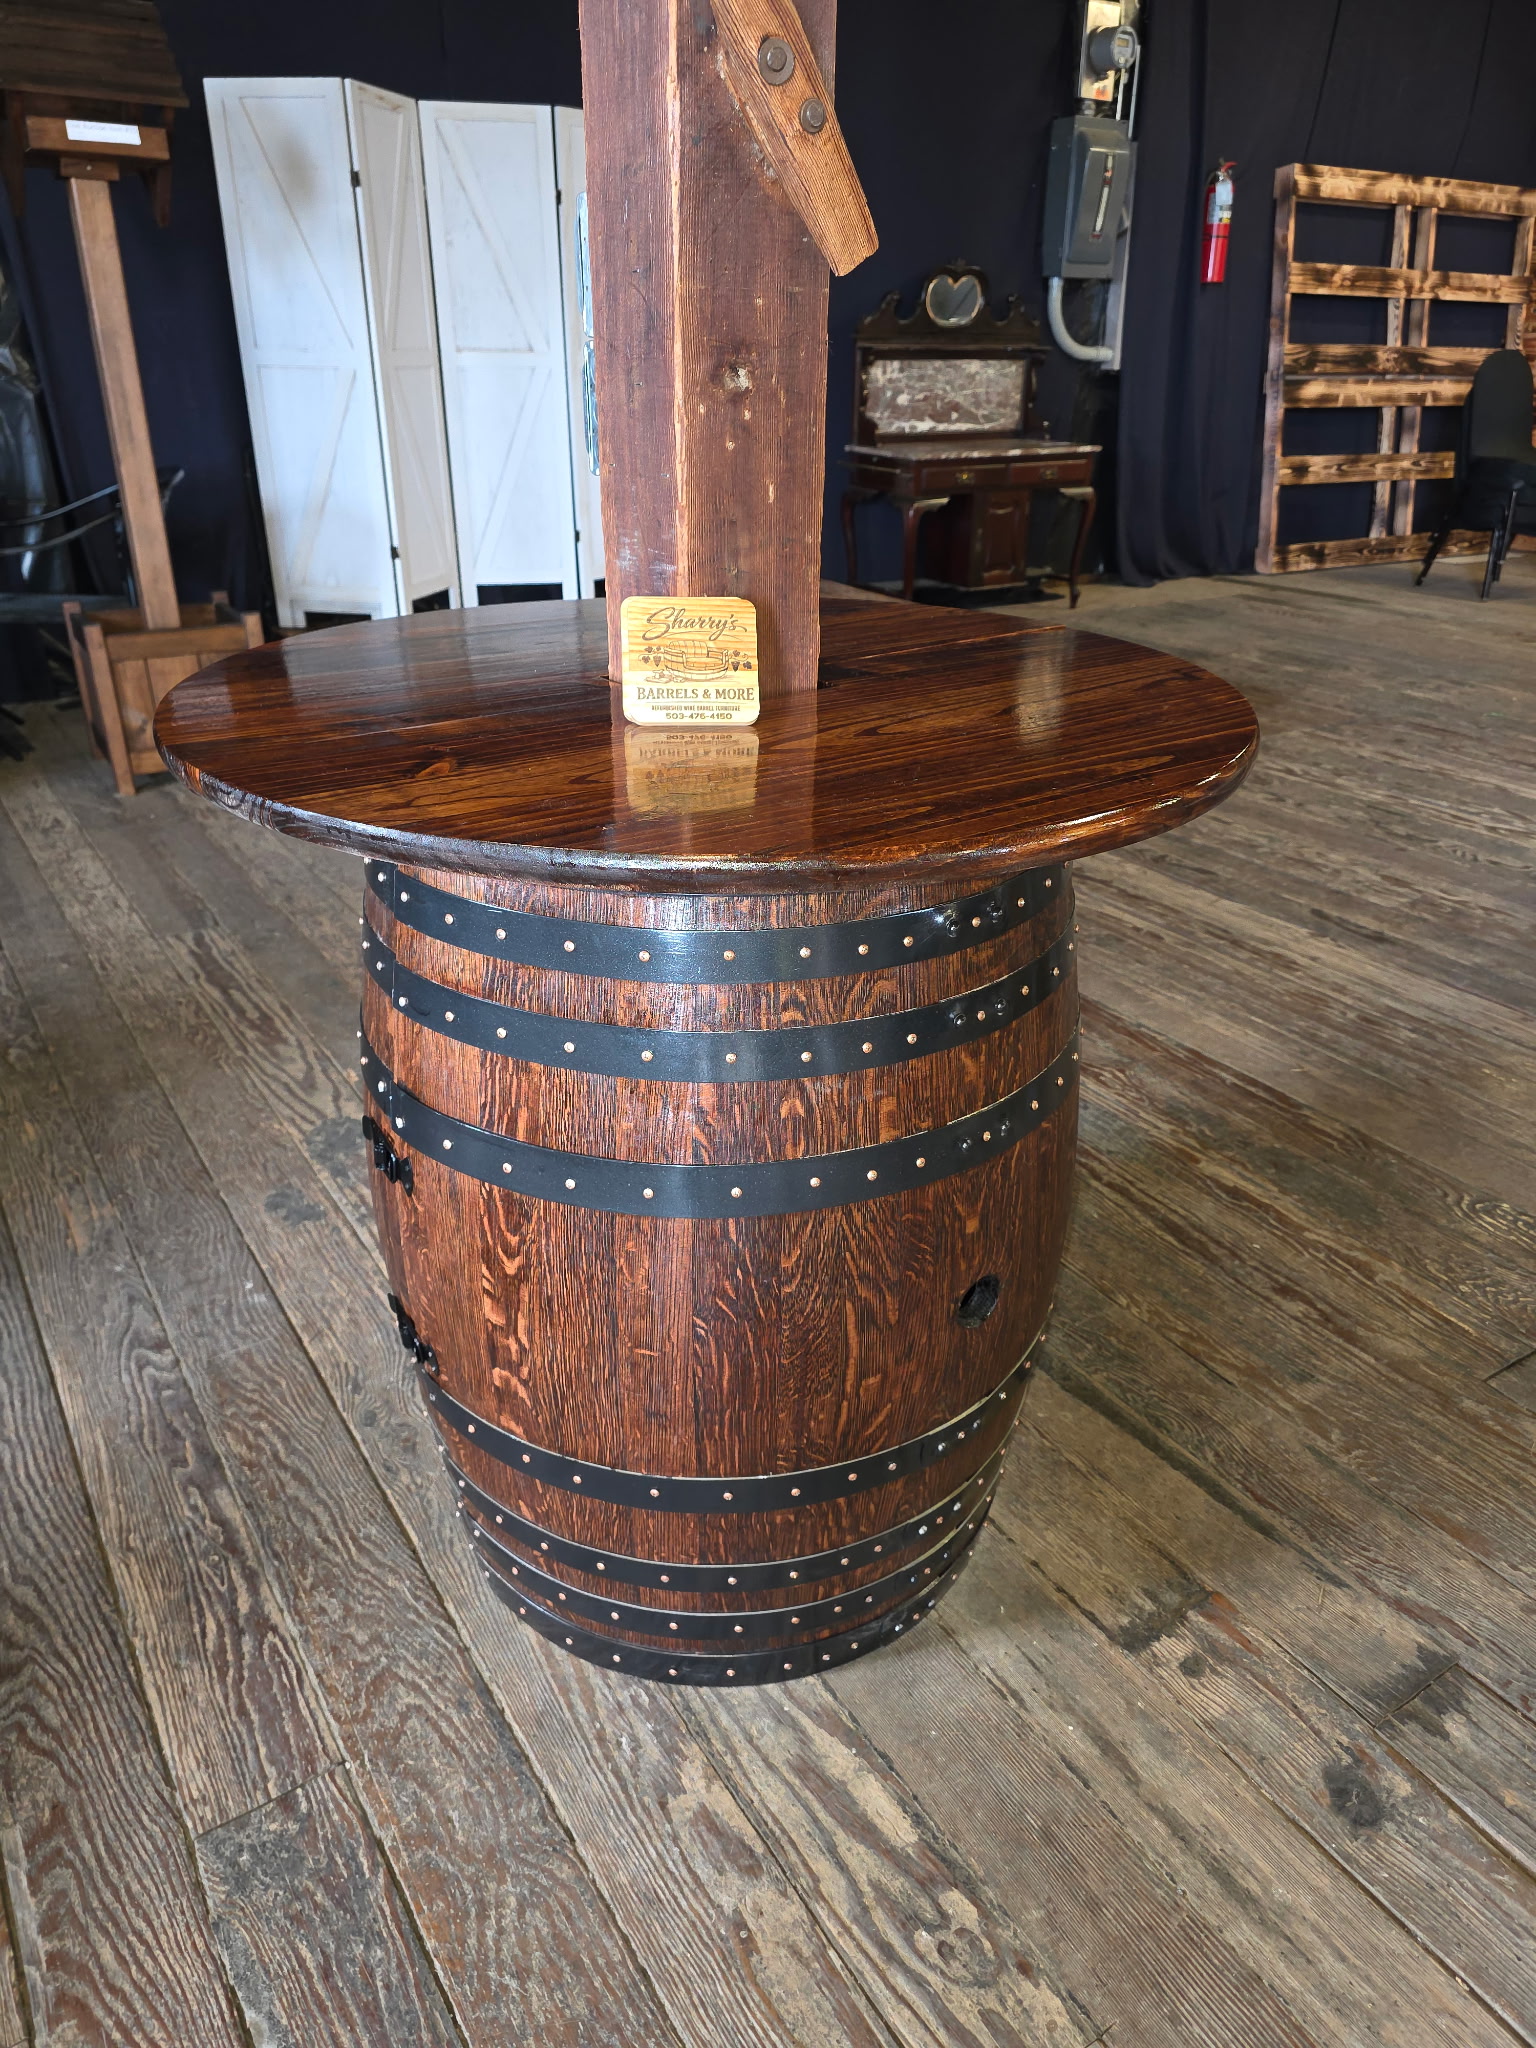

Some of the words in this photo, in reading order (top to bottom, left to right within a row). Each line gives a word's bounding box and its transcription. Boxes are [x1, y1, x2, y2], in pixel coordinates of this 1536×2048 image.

[642, 607, 747, 641] Sharry's
[637, 687, 699, 700] BARRELS
[702, 688, 711, 699] &
[718, 688, 755, 701] MORE
